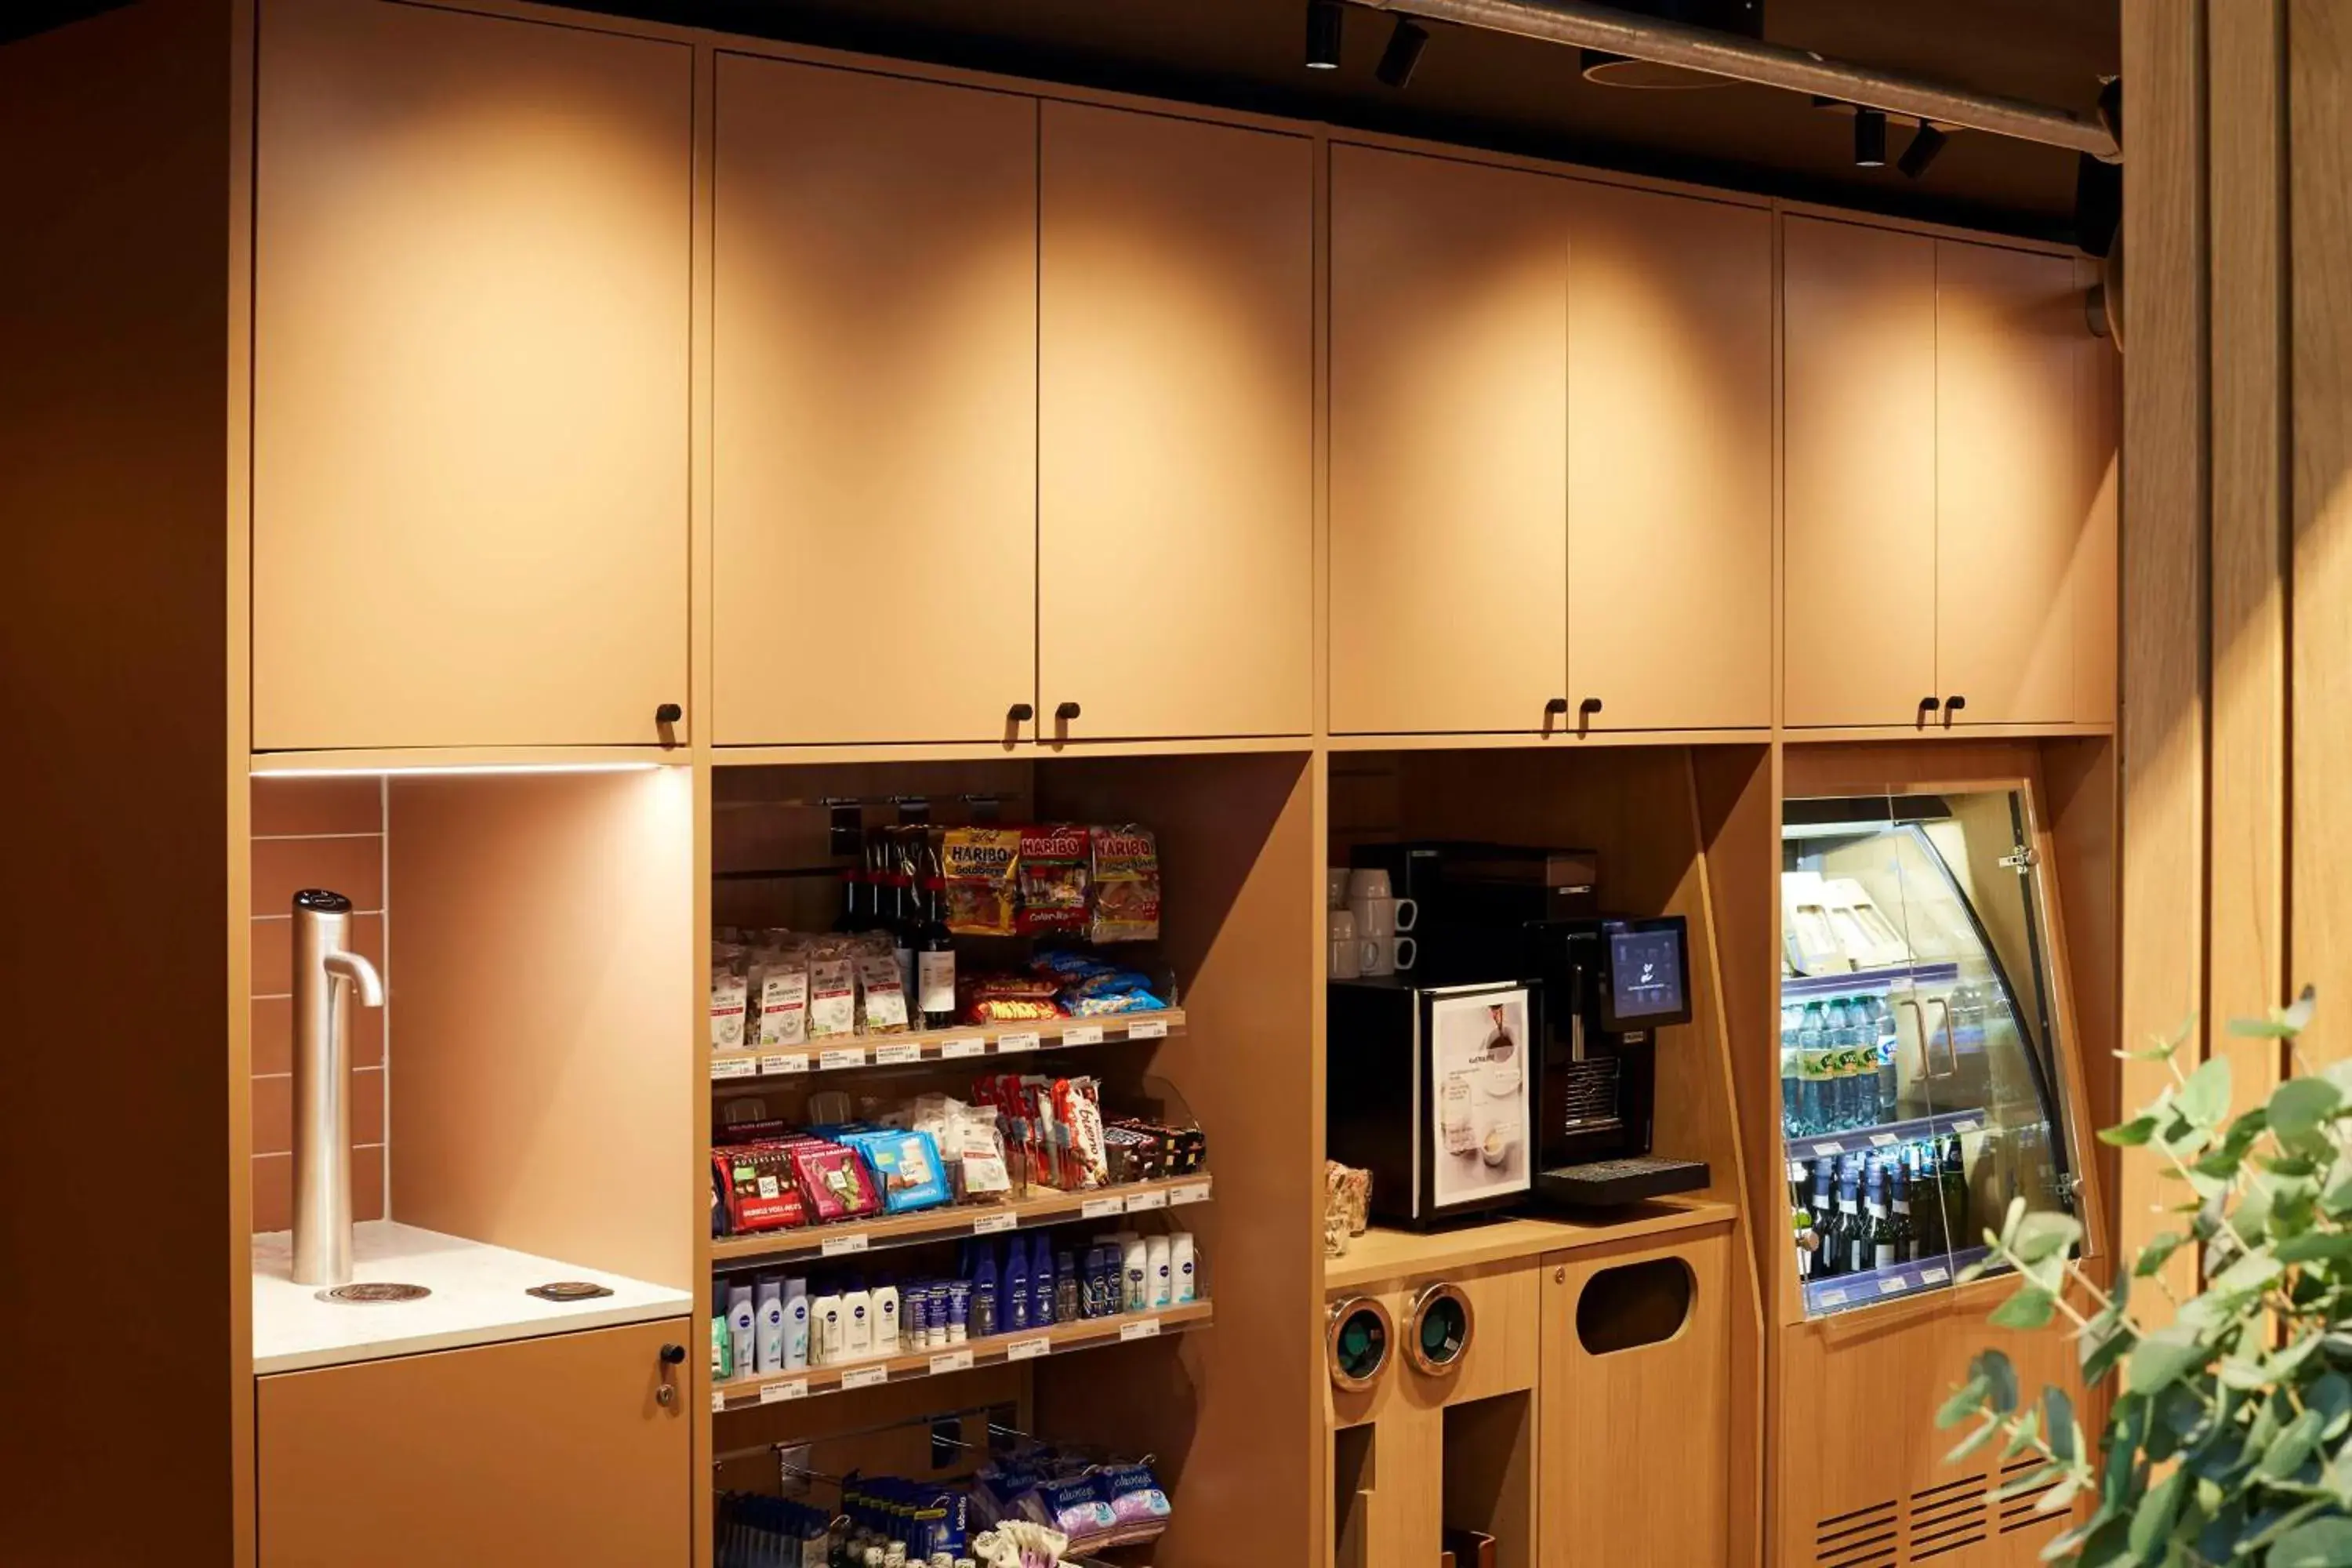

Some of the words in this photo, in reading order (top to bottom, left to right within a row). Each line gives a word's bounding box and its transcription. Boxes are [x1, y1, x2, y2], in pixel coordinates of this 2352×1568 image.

[953, 846, 1008, 862] HARIBO
[1022, 837, 1080, 855] HARIBO
[1099, 838, 1152, 856] HARIBO
[1079, 1109, 1098, 1155] bueno
[1114, 1473, 1152, 1487] always
[1059, 1486, 1096, 1501] always
[956, 1496, 967, 1531] Labello
